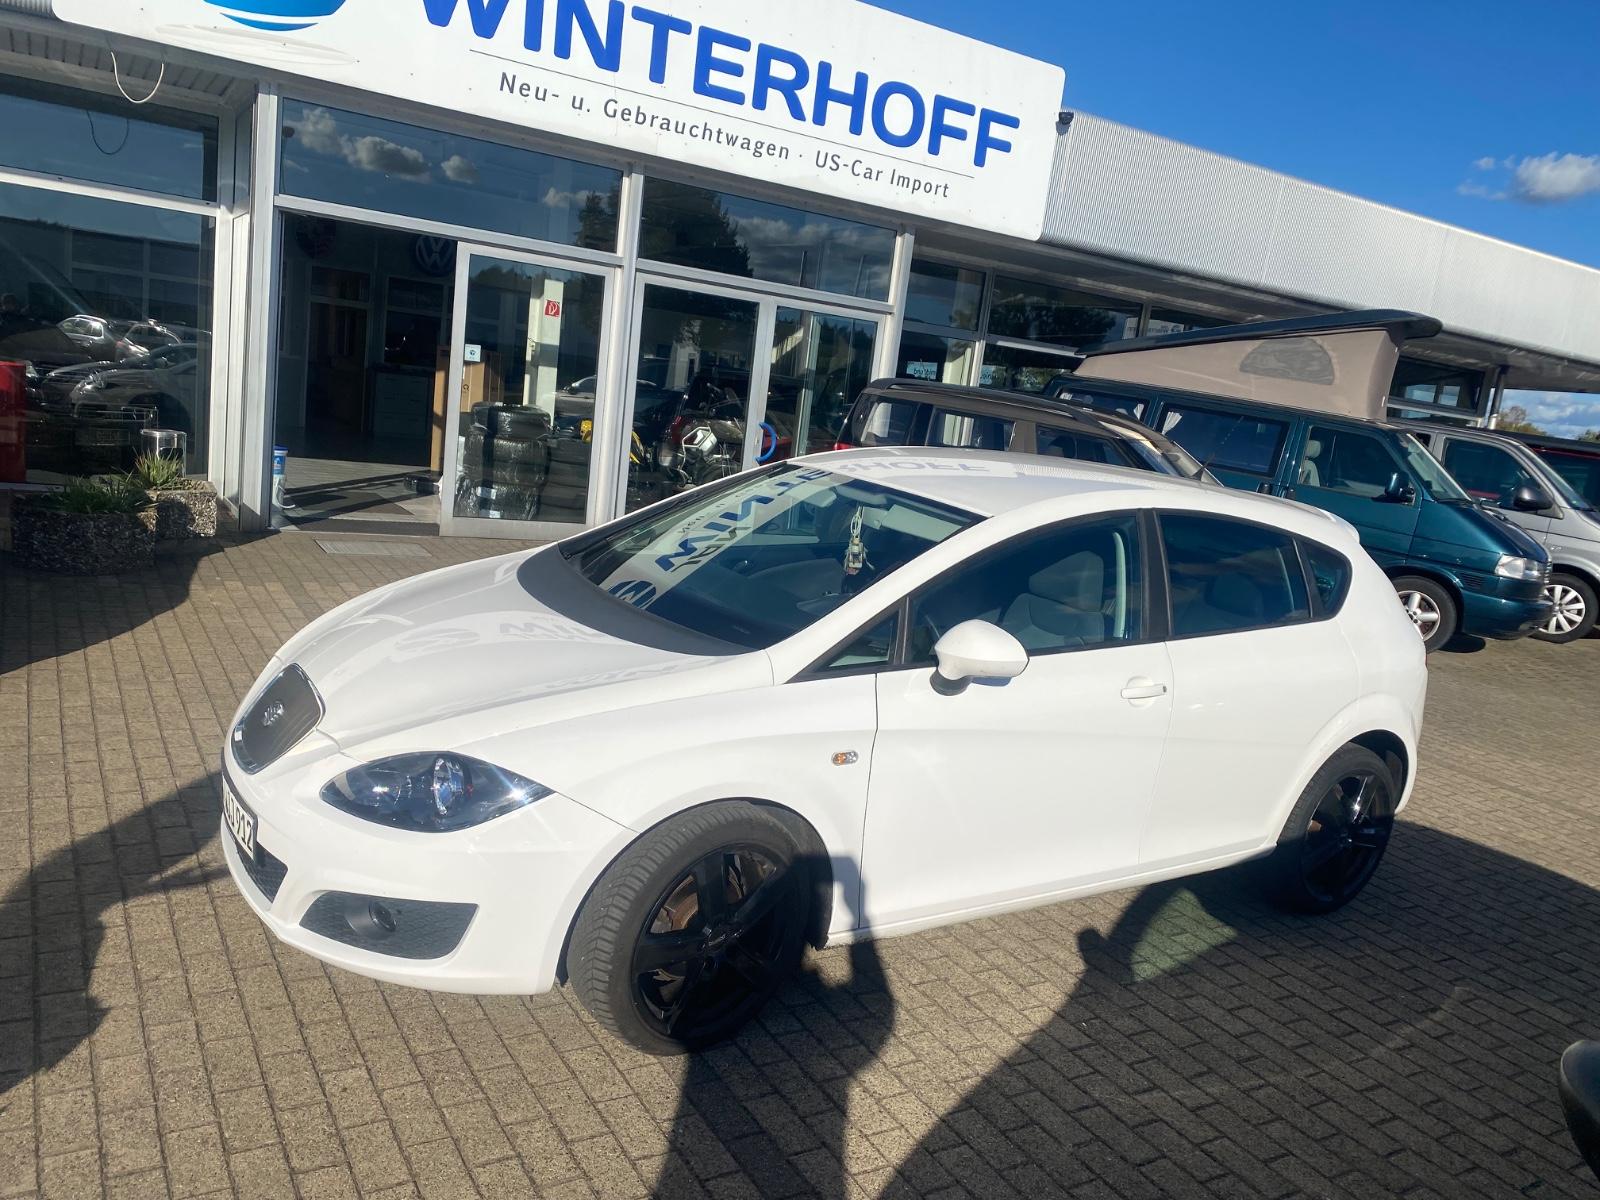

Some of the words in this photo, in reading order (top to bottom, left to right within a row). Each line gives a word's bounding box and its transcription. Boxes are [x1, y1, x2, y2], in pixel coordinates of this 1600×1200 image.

[499, 71, 560, 102] Neu-
[571, 95, 592, 113] u.
[603, 98, 790, 160] Gebrauchtwagen
[815, 150, 884, 182] US-Car
[890, 169, 950, 198] Import
